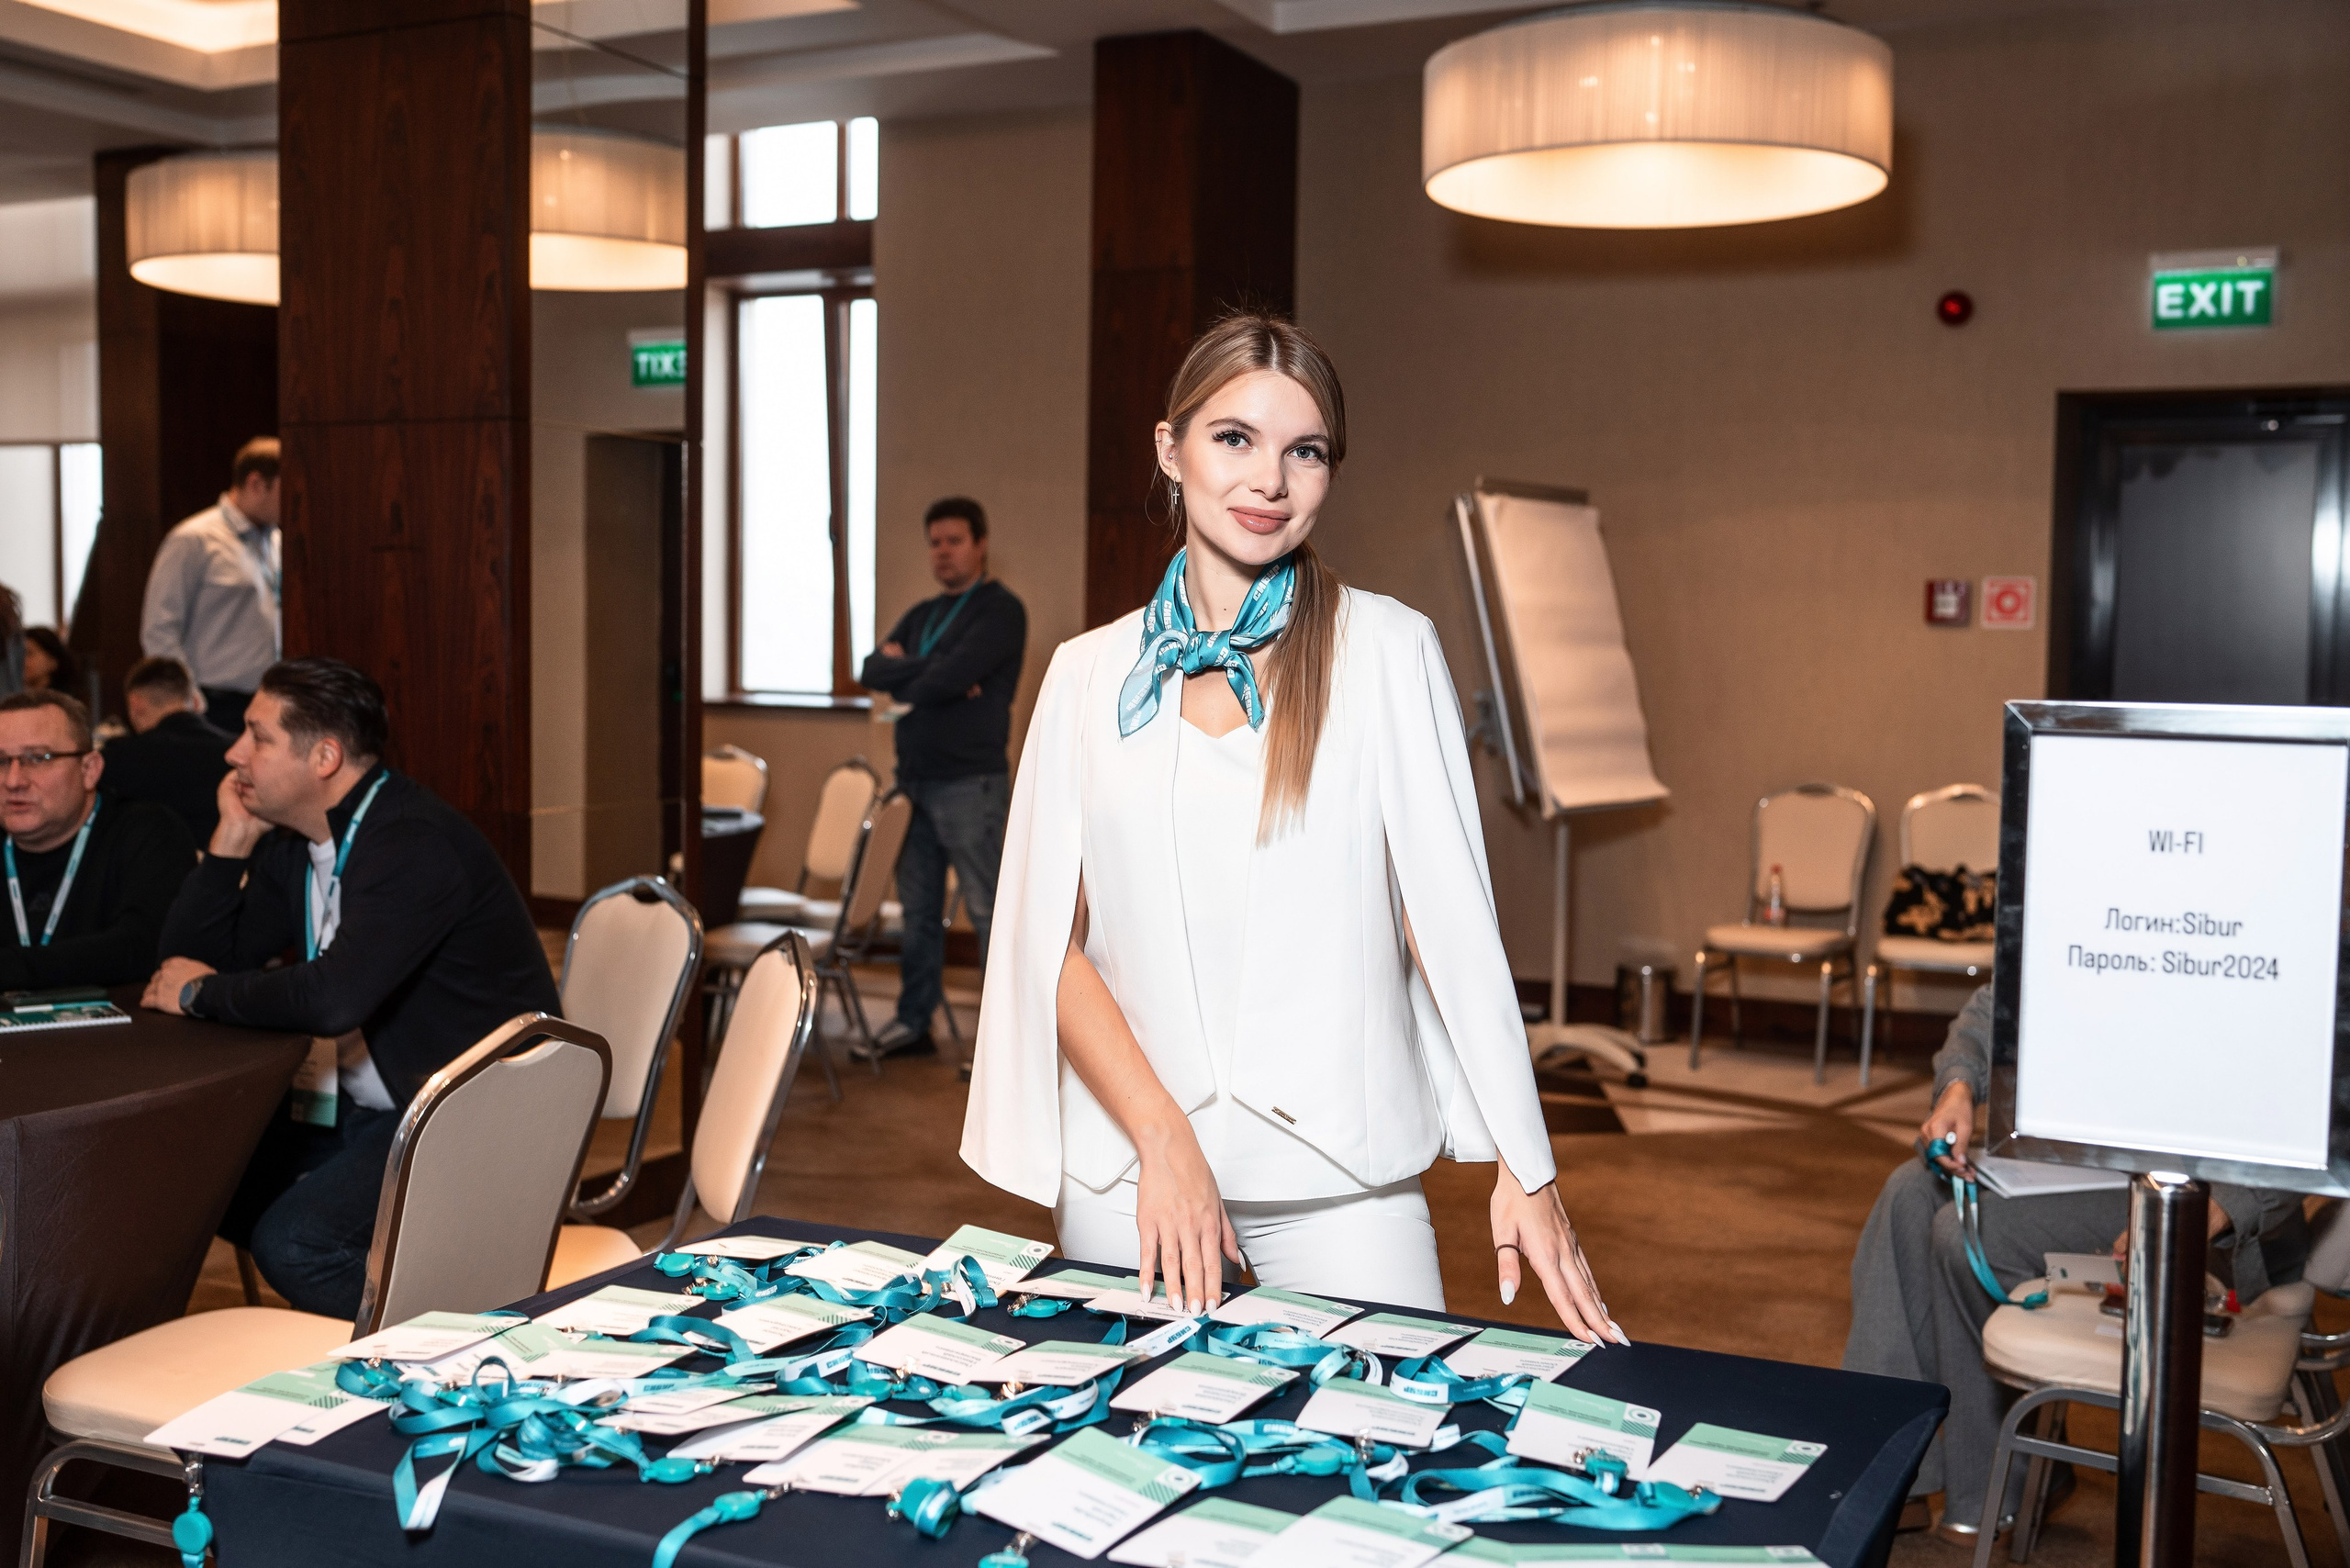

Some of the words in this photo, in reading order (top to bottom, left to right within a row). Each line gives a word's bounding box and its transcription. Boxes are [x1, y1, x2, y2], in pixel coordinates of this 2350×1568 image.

[2158, 280, 2265, 318] EXIT
[1252, 564, 1281, 602] СИБУР
[2149, 830, 2204, 854] WI-FI
[2105, 907, 2243, 936] Логин:Sibur
[2068, 945, 2156, 975] Пароль:
[2162, 950, 2278, 980] Sibur2024
[1167, 1325, 1192, 1344] СИБУР
[1403, 1385, 1438, 1397] СИБУР
